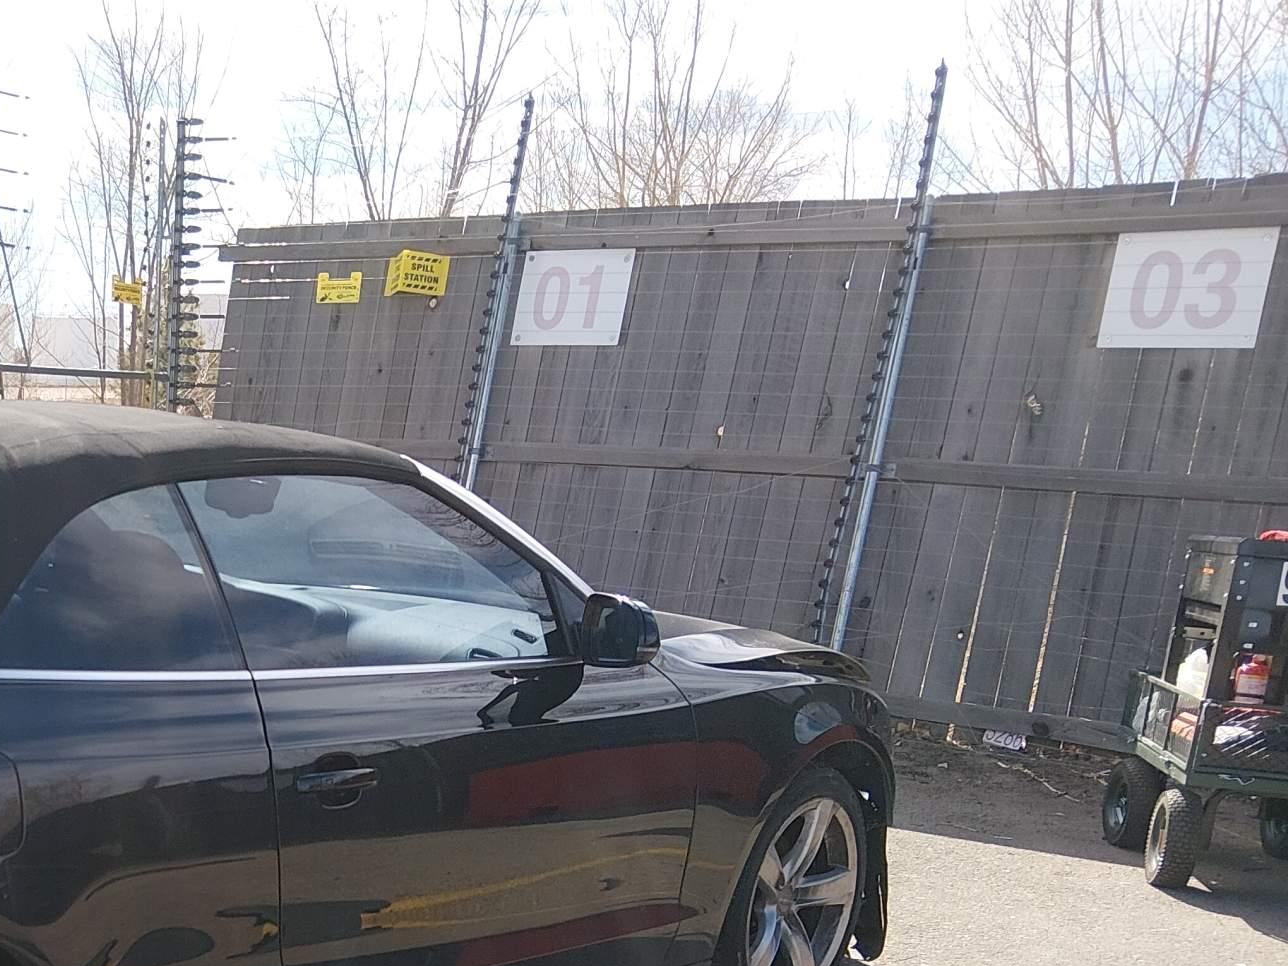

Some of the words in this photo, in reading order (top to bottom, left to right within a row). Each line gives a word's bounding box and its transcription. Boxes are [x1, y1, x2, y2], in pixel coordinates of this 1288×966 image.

[404, 272, 439, 285] STATION
[411, 262, 435, 273] SPILL
[533, 264, 605, 331] 01
[1130, 248, 1242, 331] 03
